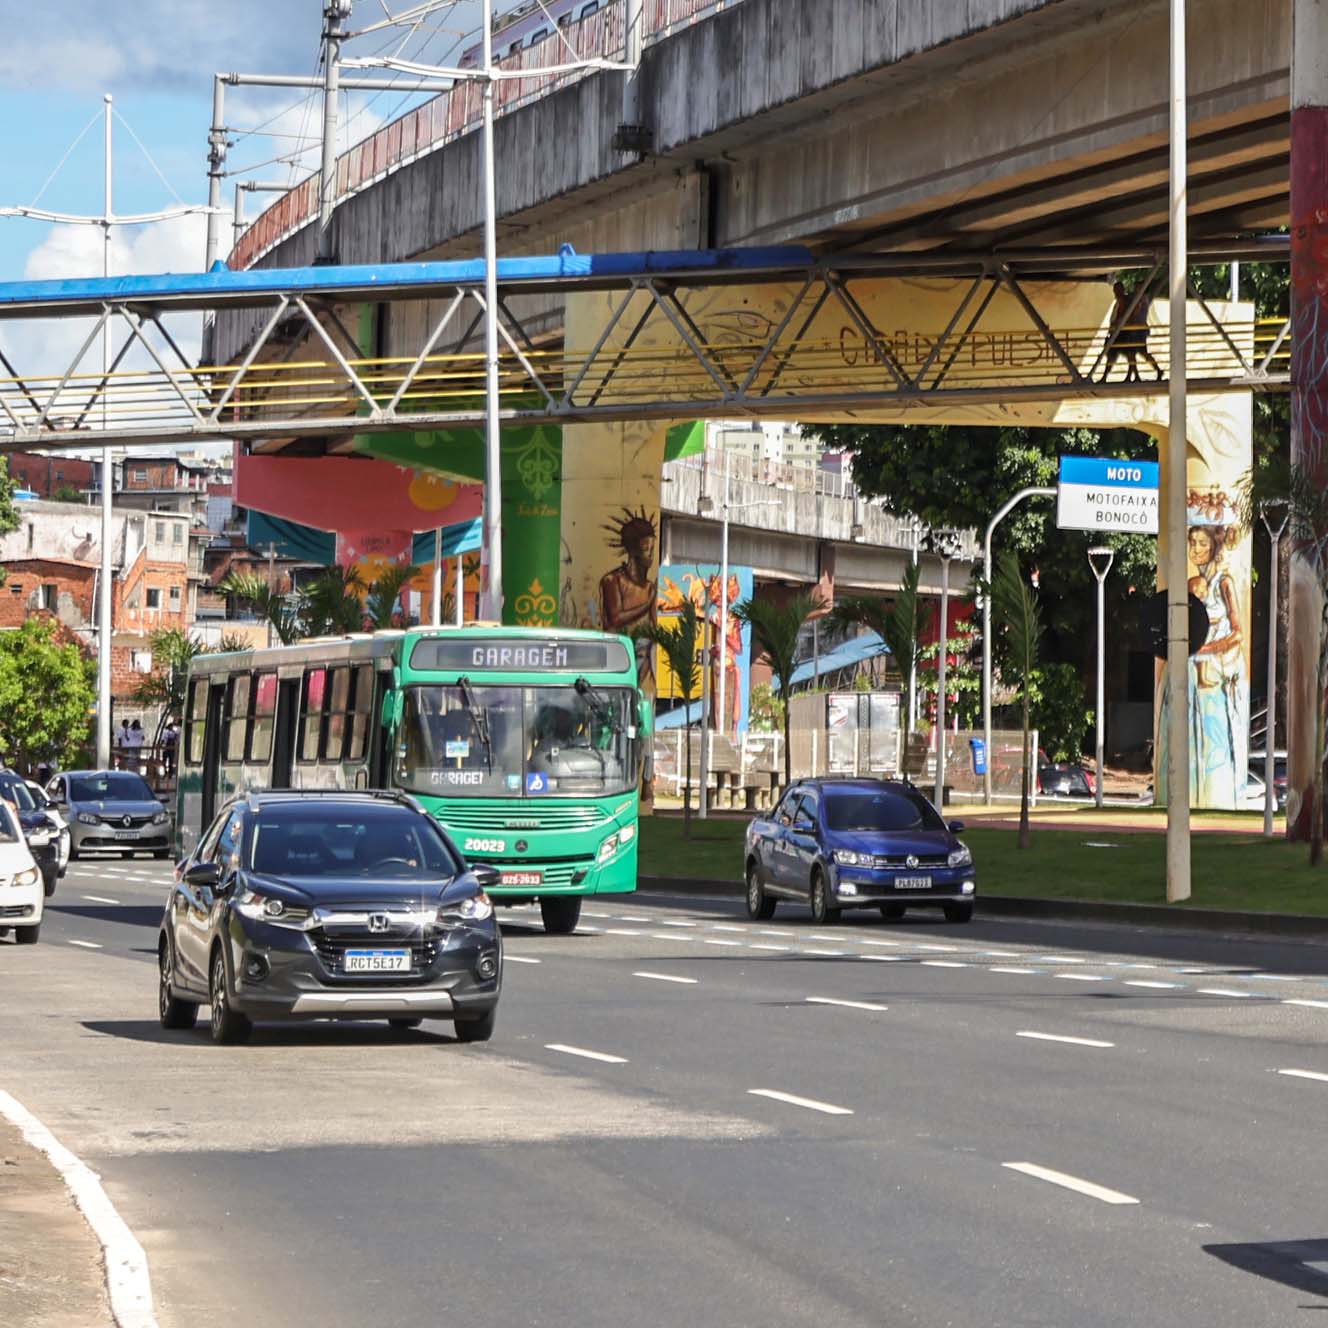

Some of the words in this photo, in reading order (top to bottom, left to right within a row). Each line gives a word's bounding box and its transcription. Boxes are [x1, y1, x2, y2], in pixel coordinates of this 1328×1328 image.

[1107, 467, 1141, 482] MOTO
[1086, 492, 1157, 507] MOTOFAIXA
[1096, 510, 1148, 525] BONOCÔ
[464, 838, 505, 853] 20023
[350, 957, 403, 969] RCT5E17
